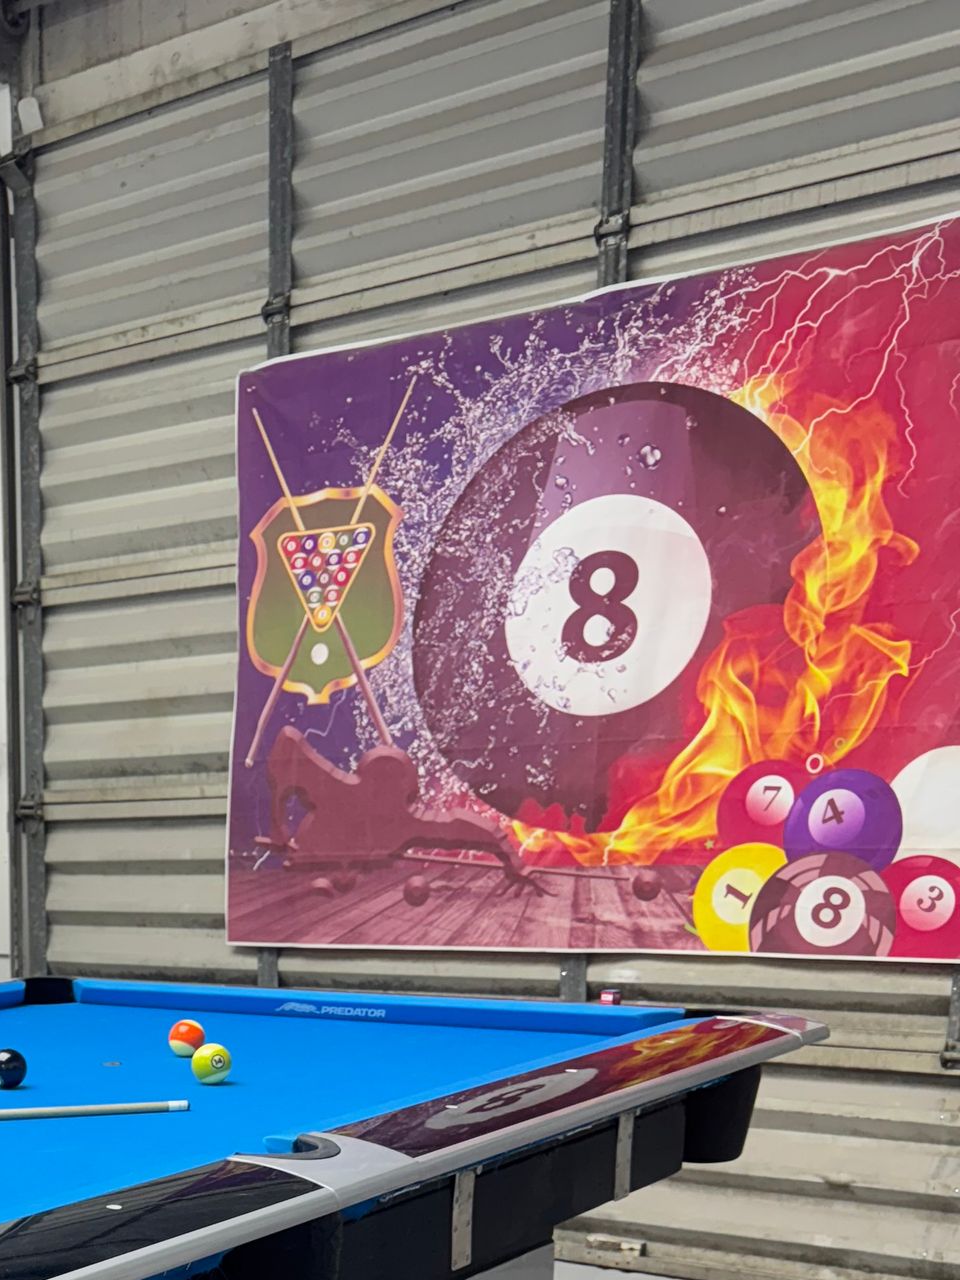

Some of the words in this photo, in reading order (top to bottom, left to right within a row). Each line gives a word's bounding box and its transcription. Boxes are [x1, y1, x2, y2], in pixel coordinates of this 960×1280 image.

[561, 550, 639, 664] 8
[762, 785, 782, 811] 7
[821, 797, 845, 825] 4
[724, 883, 753, 910] 1
[811, 887, 851, 929] 8
[916, 885, 945, 913] 3
[320, 1005, 386, 1018] PREDATOR
